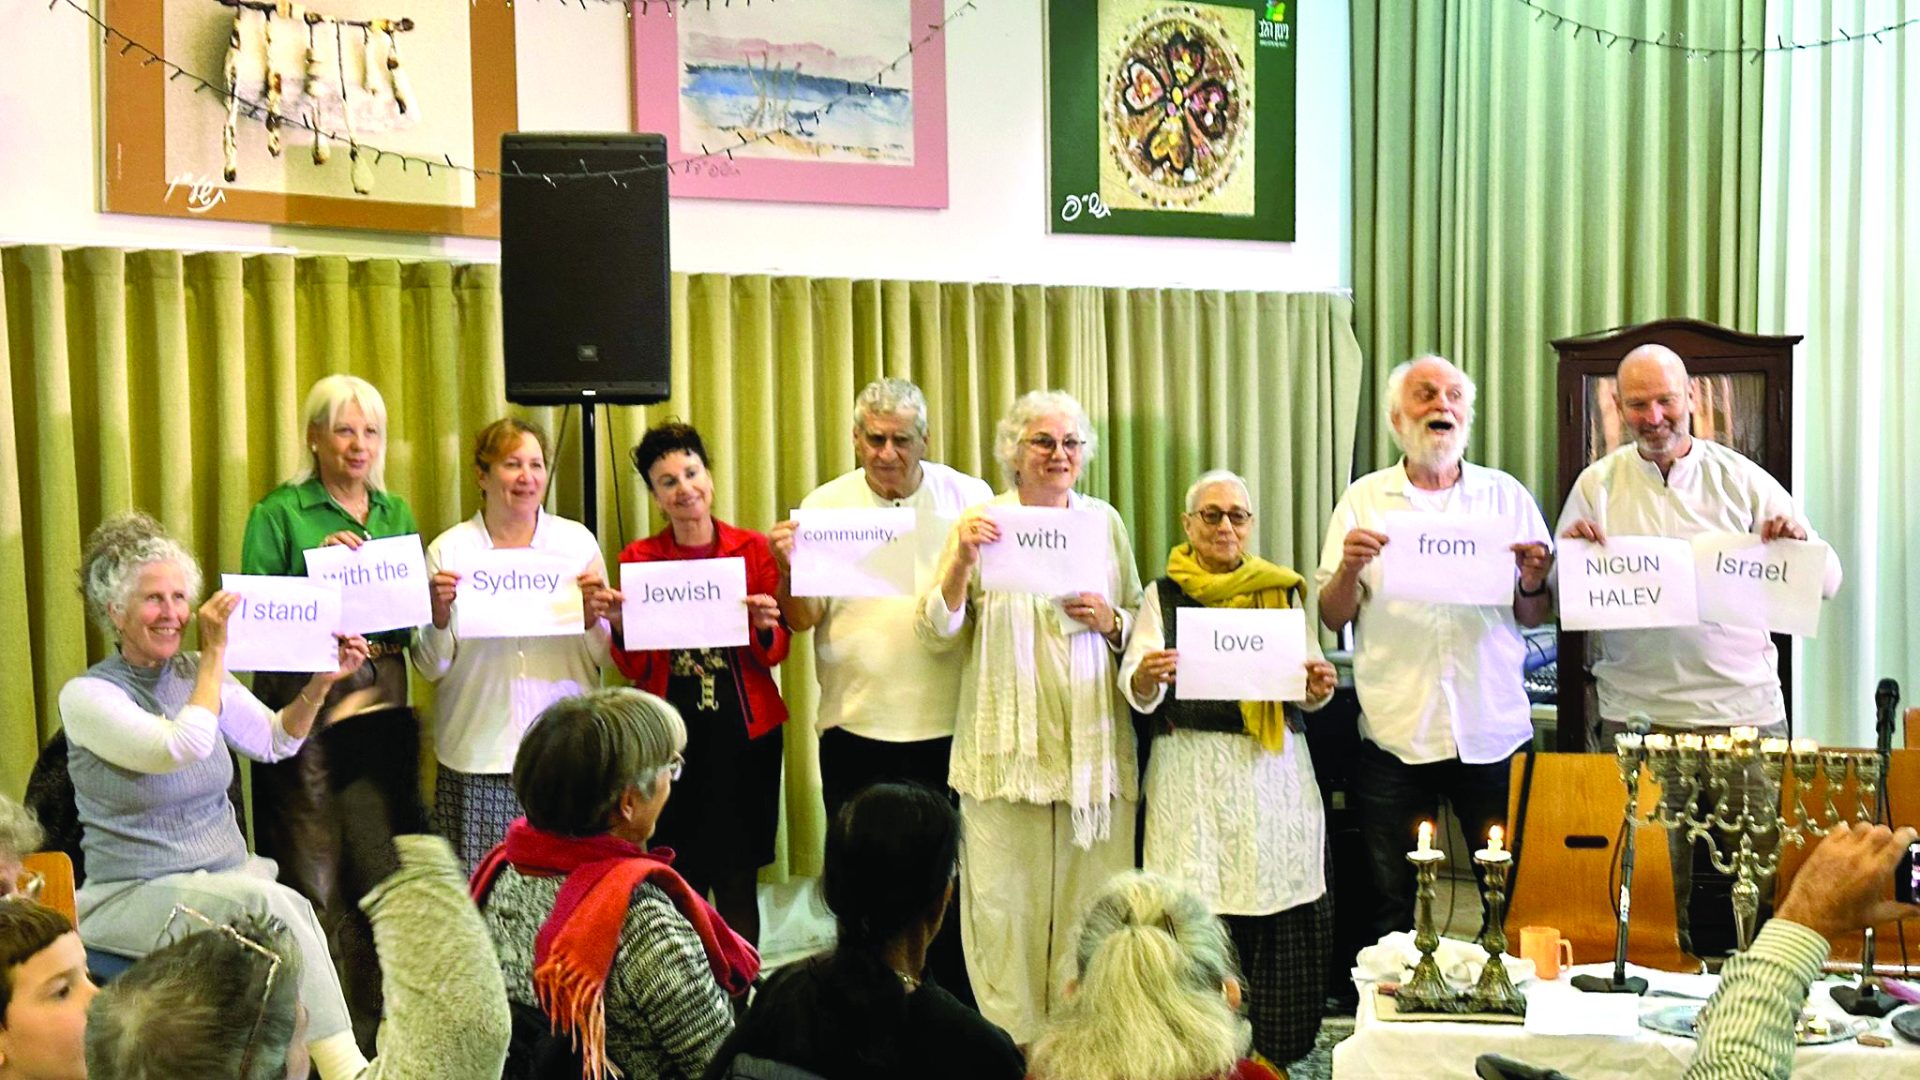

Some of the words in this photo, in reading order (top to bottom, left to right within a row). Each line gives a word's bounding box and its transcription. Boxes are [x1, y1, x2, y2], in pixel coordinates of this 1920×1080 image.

[1015, 527, 1068, 550] with
[1417, 533, 1476, 557] from
[375, 560, 409, 582] the
[1585, 554, 1660, 576] NIGUN
[1715, 550, 1789, 584] Israel
[472, 568, 560, 596] Sydney
[641, 580, 721, 604] Jewish
[1588, 586, 1662, 608] HALEV
[241, 598, 247, 620] I
[253, 599, 318, 623] stand
[1213, 629, 1265, 653] love
